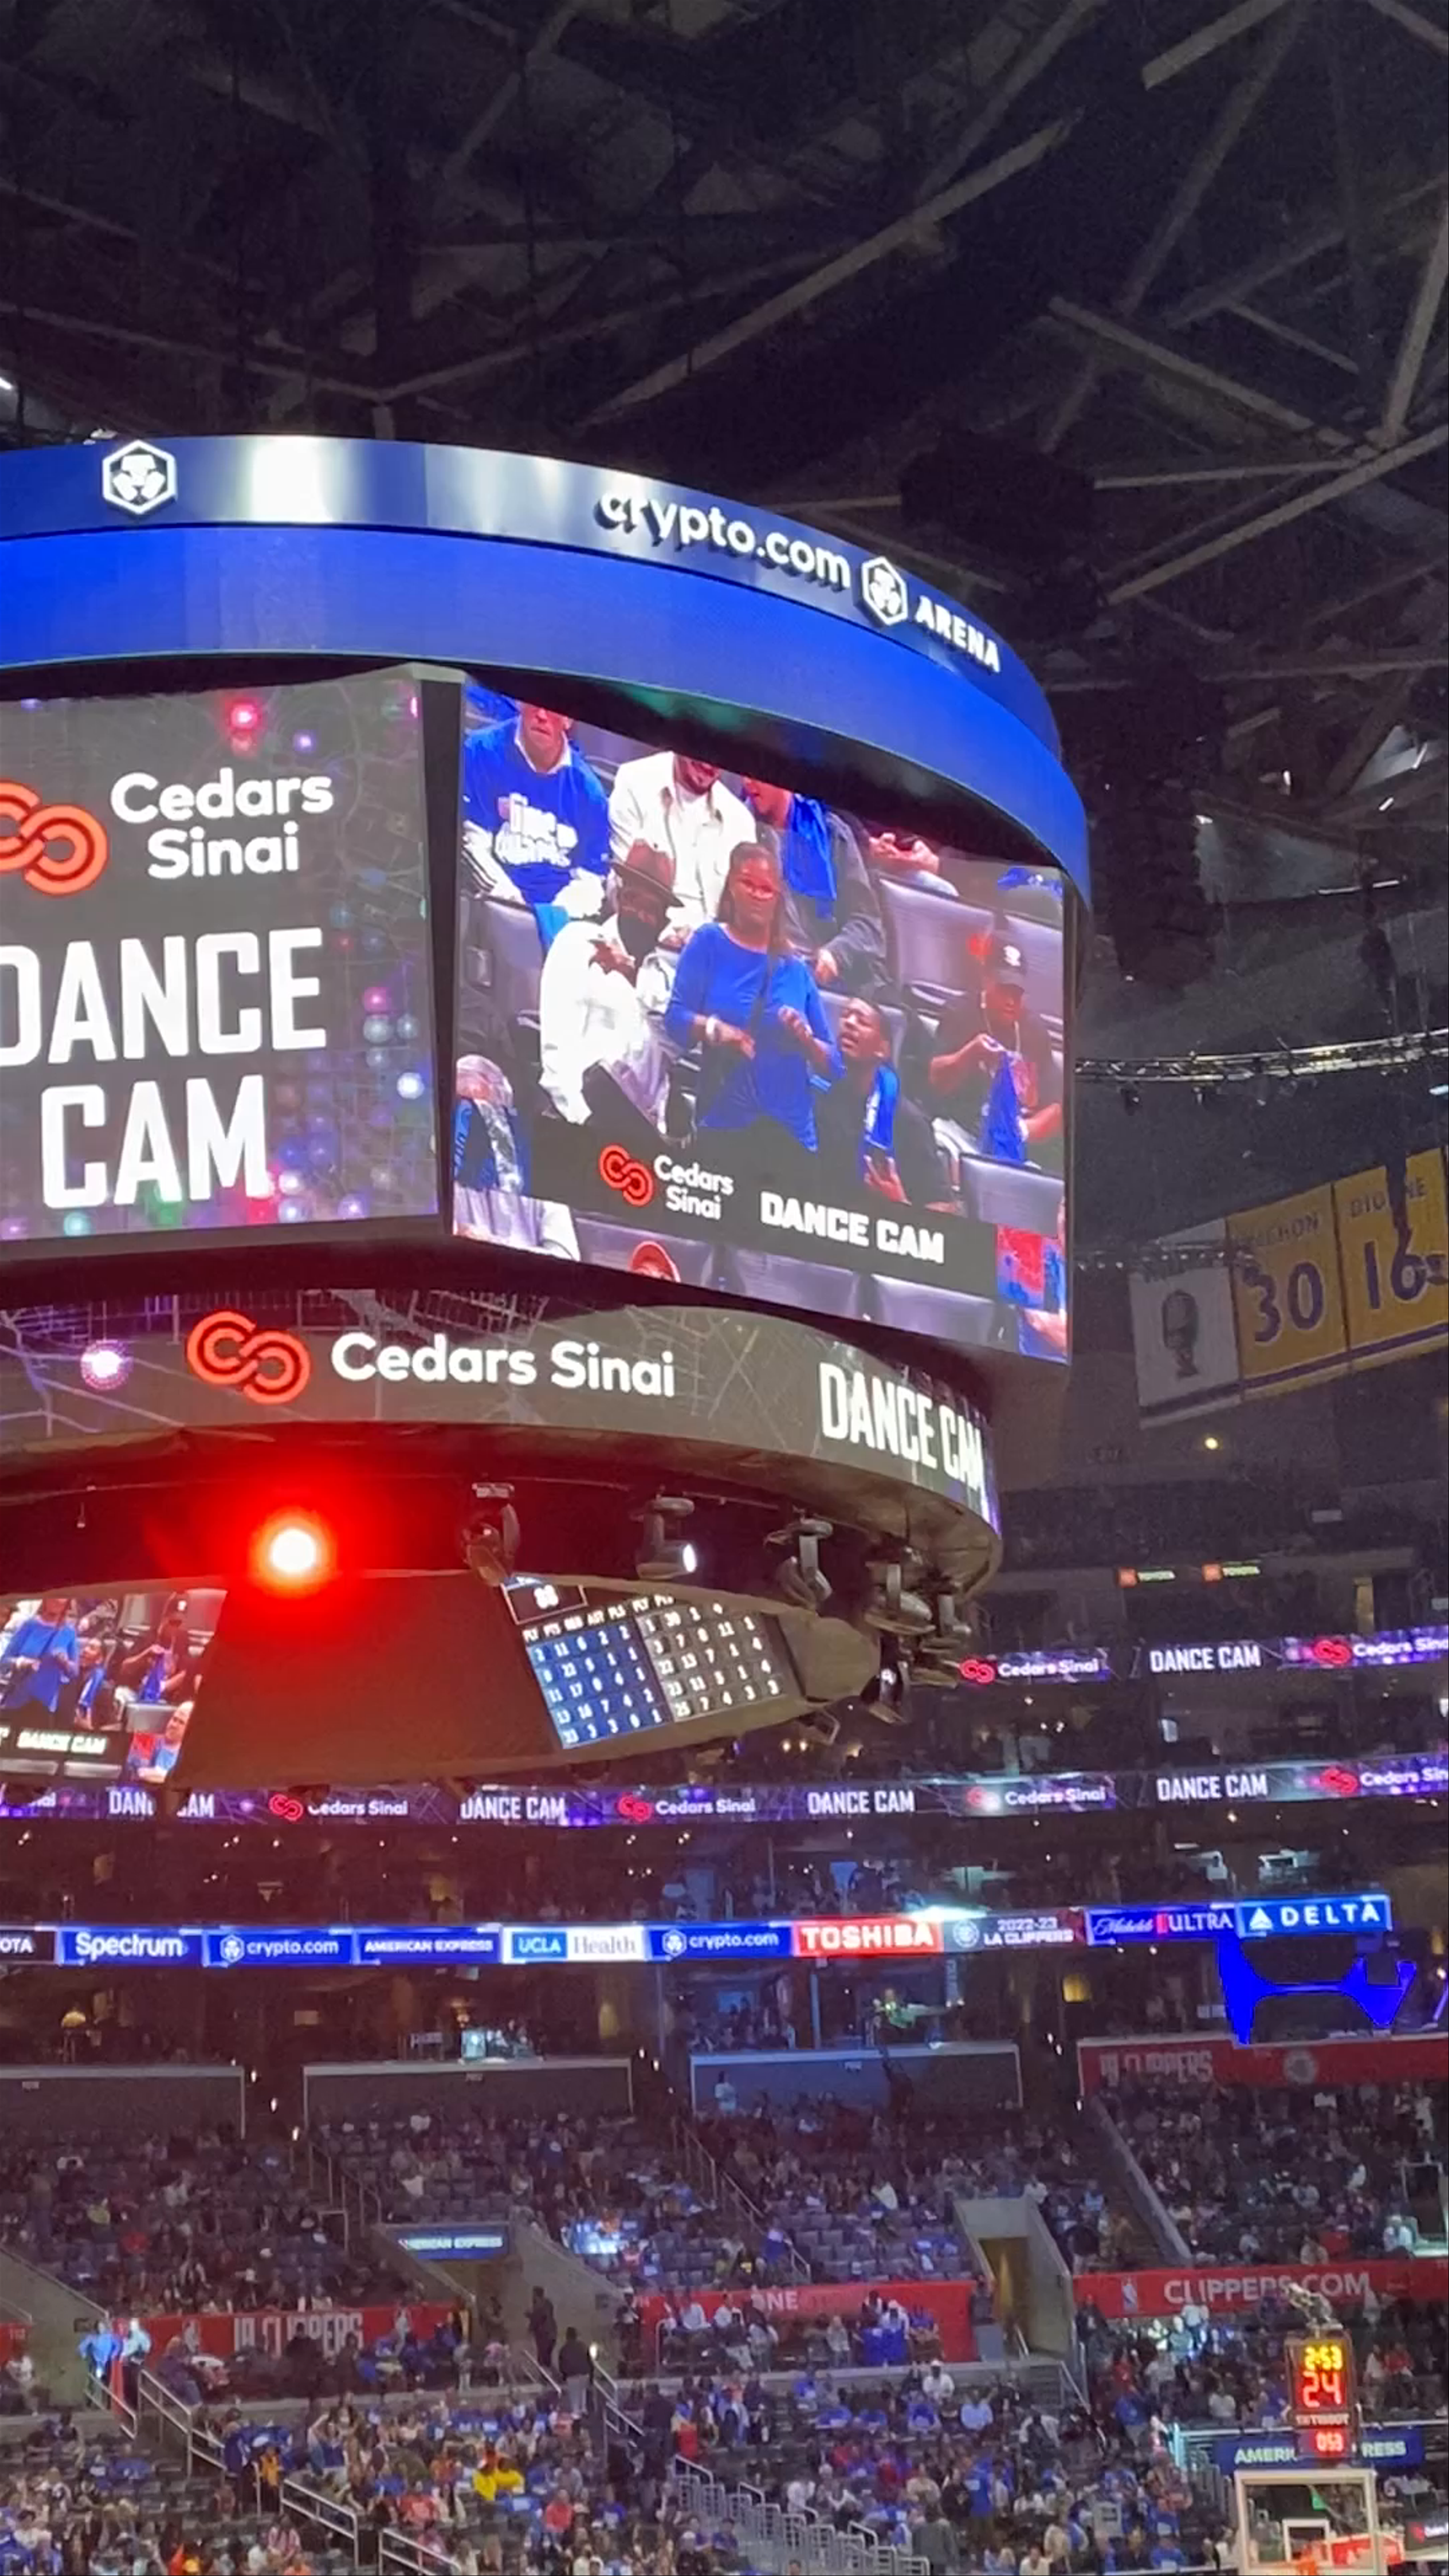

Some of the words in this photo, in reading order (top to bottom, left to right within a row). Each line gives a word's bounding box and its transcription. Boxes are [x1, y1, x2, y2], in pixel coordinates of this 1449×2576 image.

[601, 491, 850, 588] crypto.com
[915, 596, 1000, 672] ARENA
[111, 768, 333, 823] Cedars
[148, 821, 298, 878] Sinai
[0, 928, 326, 1066] DANCE
[42, 1075, 272, 1208] CAM
[654, 1155, 733, 1195] Cedars
[666, 1186, 721, 1220] Sinai
[761, 1192, 869, 1246] DANCE
[877, 1220, 943, 1263] CAM
[1243, 1262, 1323, 1343] 30
[332, 1333, 537, 1384] Cedars
[551, 1341, 674, 1397] Sinai
[820, 1363, 937, 1469] DANCE
[940, 1406, 983, 1491] CAM
[1151, 1648, 1214, 1672] DANCE
[1218, 1646, 1260, 1668] CAM
[1353, 1642, 1412, 1656] Cedars
[998, 1662, 1056, 1676] Cedars
[1058, 1659, 1098, 1674] Sinai
[1157, 1776, 1220, 1800] DANCE
[1226, 1774, 1267, 1797] CAM
[1360, 1772, 1418, 1786] Cedars
[369, 1800, 407, 1815] Sinai
[527, 1796, 565, 1819] CAM
[655, 1801, 713, 1814] Cedars
[717, 1799, 755, 1812] Sinai
[809, 1792, 869, 1813] DANCE
[875, 1791, 914, 1812] CAM
[1005, 1790, 1063, 1806] Cedars
[1066, 1787, 1105, 1802] Sinai
[1168, 1913, 1233, 1931] ULTRA
[1281, 1903, 1379, 1926] DELTA
[76, 1932, 183, 1961] Spectrum
[247, 1938, 338, 1958] crypto.com
[365, 1940, 432, 1952] AMERICAN
[518, 1937, 561, 1953] UCLA
[574, 1936, 636, 1953] Health
[690, 1932, 778, 1950] crypto.com
[802, 1923, 934, 1950] TOSHIBA
[984, 1933, 1003, 1945] LA
[1005, 1929, 1074, 1944] CLIPPERS
[1164, 2272, 1370, 2303] CLIPPERSCOM
[1303, 2371, 1341, 2407] 24
[1362, 2441, 1406, 2458] RESS
